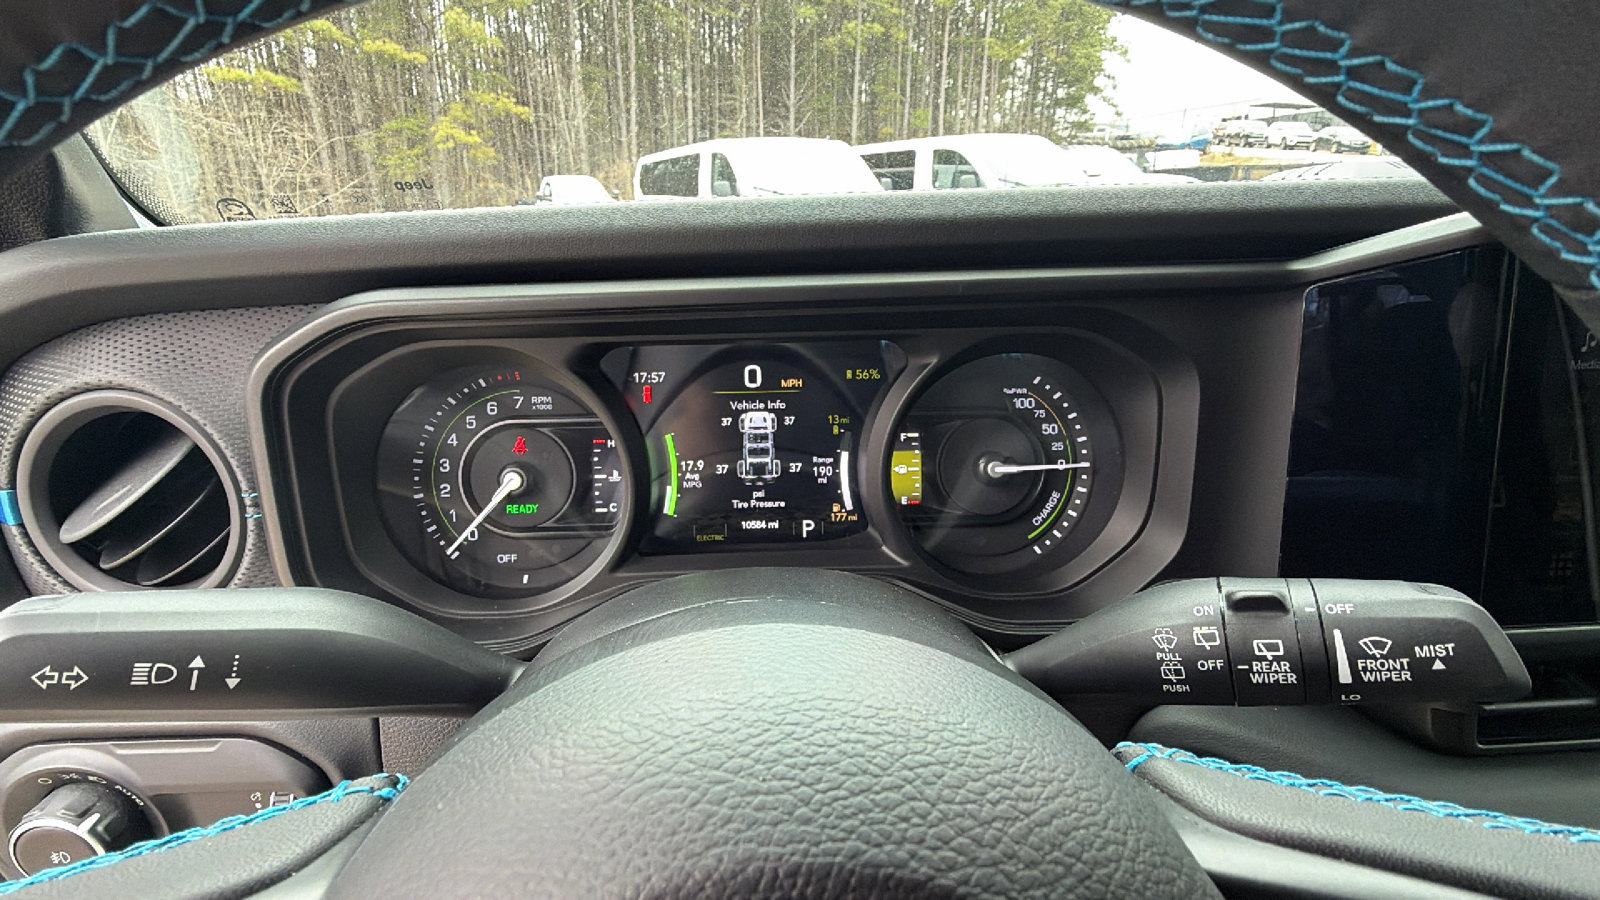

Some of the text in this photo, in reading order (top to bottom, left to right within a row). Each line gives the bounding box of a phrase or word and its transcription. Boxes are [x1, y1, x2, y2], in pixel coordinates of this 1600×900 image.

[633, 371, 666, 383] 17:57
[855, 369, 881, 380] 56%
[781, 378, 802, 388] MPH
[513, 396, 524, 409] 7
[531, 396, 553, 404] RPM
[729, 400, 786, 410] Vehicle Info
[1013, 398, 1036, 409] 100
[486, 401, 498, 415] 6
[1033, 410, 1046, 418] 75
[465, 415, 477, 429] 5
[721, 418, 733, 427] 37
[783, 416, 796, 425] 37
[828, 415, 840, 424] 13
[1041, 423, 1058, 435] 50
[447, 433, 459, 447] 4
[900, 432, 908, 442] F
[607, 440, 615, 448] H
[1051, 442, 1064, 451] 25
[439, 458, 450, 472] 3
[812, 456, 834, 464] Range
[681, 460, 704, 471] 17.9
[715, 464, 729, 474] 37
[789, 463, 802, 473] 37
[685, 472, 700, 481] Avg
[813, 466, 833, 477] 190
[683, 480, 702, 488] MPG
[817, 476, 828, 484] mi
[440, 485, 451, 498] 2
[752, 489, 766, 499] psi
[731, 499, 786, 509] Tire Pressure
[901, 496, 908, 505] E
[506, 504, 539, 514] READY
[609, 503, 618, 512] C
[1032, 491, 1061, 526] CHARGE
[449, 509, 457, 522] 1
[830, 512, 858, 521] 177 mi
[741, 520, 779, 530] 10584 mi
[802, 520, 815, 538] P
[497, 553, 518, 564] OFF
[1193, 604, 1215, 617] ON
[1324, 603, 1354, 615] OFF
[1414, 643, 1456, 660] MIST
[1156, 652, 1183, 662] PULL
[1197, 659, 1224, 672] OFF
[1252, 661, 1291, 673] REAR
[1357, 659, 1410, 672] FRONT
[1249, 672, 1298, 685] WIPER
[1360, 671, 1413, 683] WIPER
[1162, 684, 1191, 693] PUSH
[115, 785, 144, 806] AUTO
